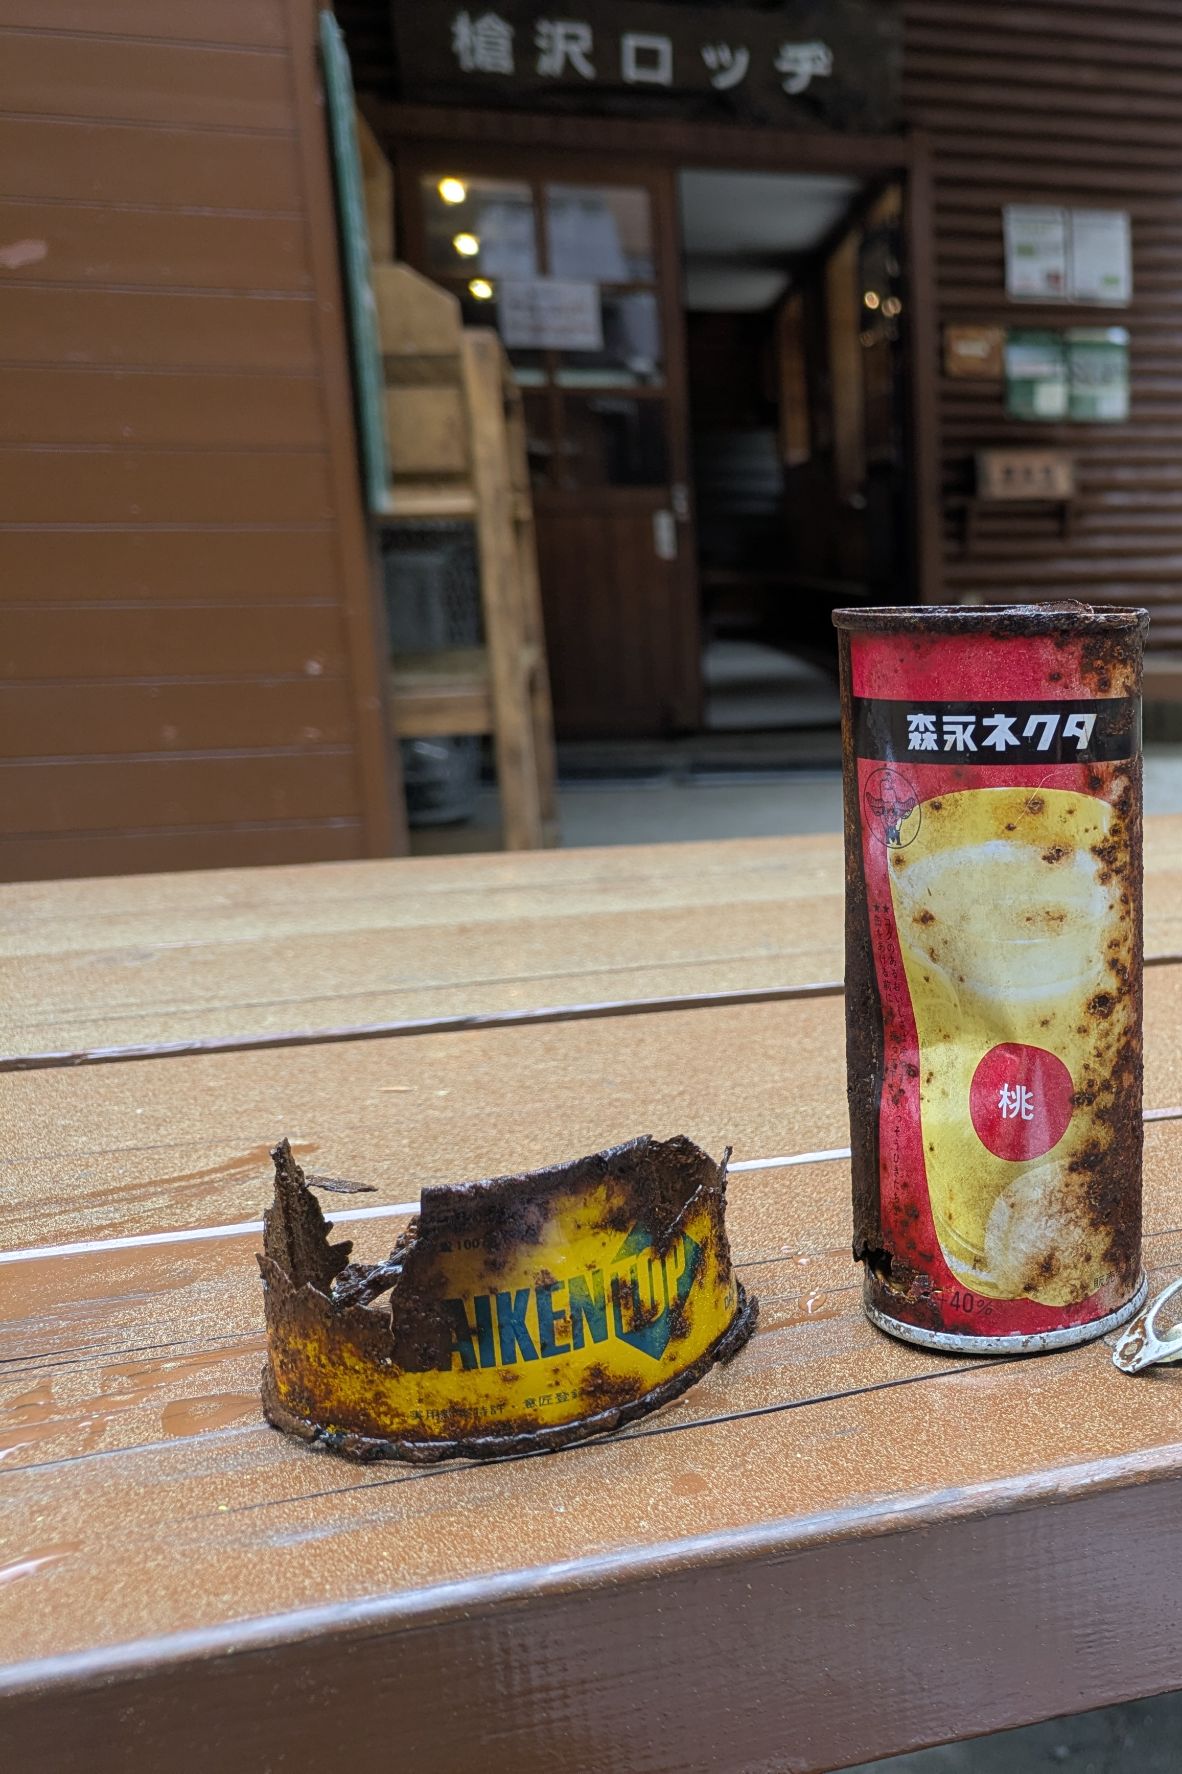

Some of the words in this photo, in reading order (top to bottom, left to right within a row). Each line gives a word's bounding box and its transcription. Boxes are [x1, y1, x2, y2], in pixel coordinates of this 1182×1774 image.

[451, 10, 832, 95] 槍沢ロッヂ
[907, 713, 1098, 752] 森永ネクタ
[997, 1083, 1035, 1121] 桃
[404, 1268, 608, 1374] AIKEN
